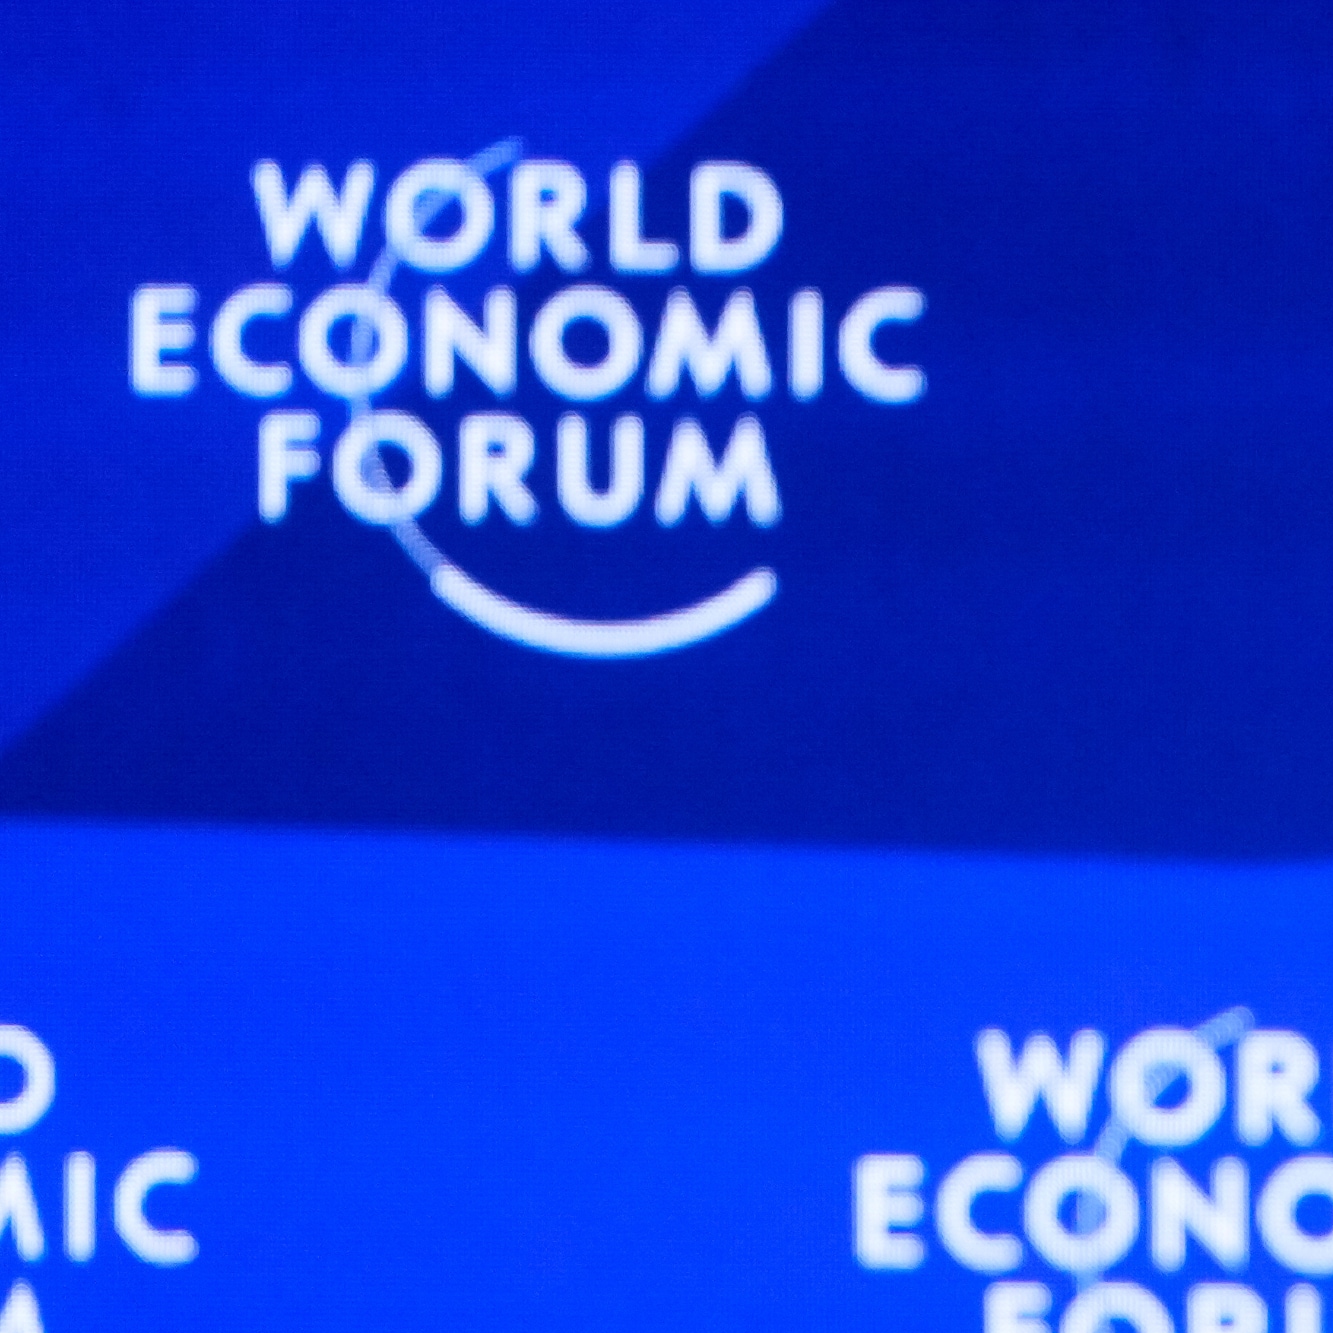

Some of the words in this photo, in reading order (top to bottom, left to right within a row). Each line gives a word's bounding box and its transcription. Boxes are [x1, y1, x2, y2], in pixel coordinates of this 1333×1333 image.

[254, 159, 784, 271] WORLD
[131, 283, 926, 402] ECONOMIC
[258, 409, 782, 527] FORUM
